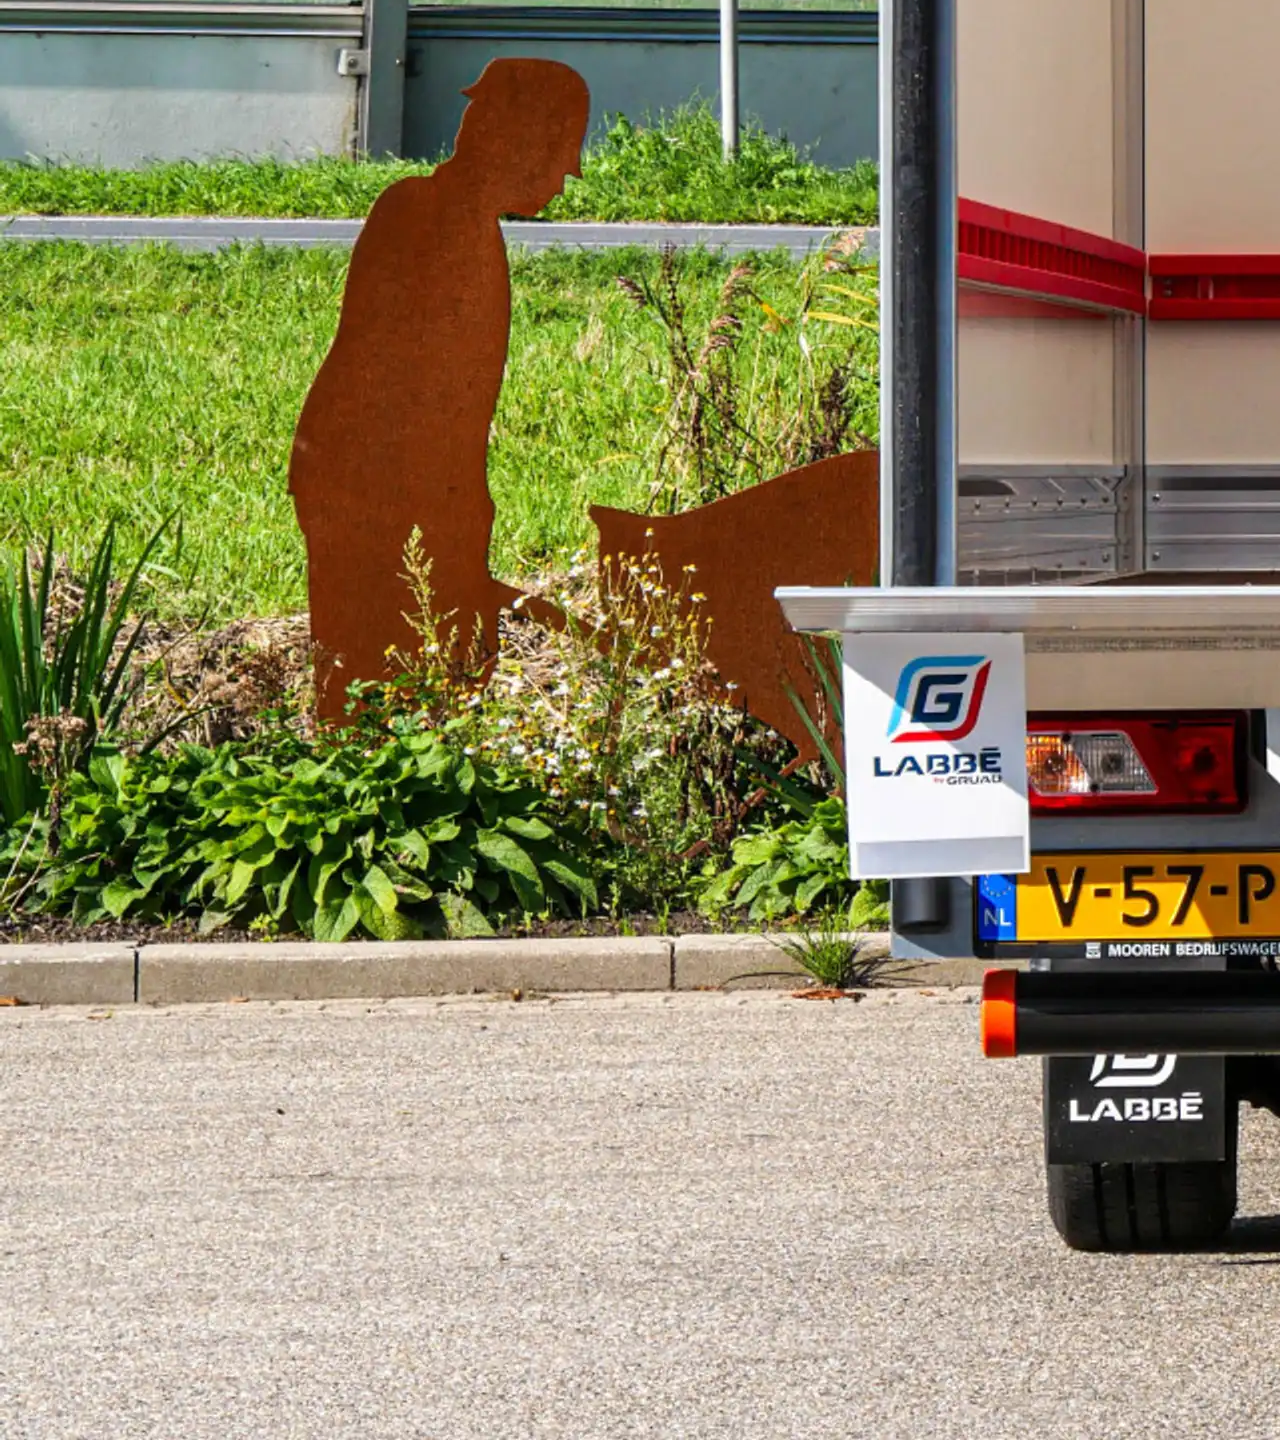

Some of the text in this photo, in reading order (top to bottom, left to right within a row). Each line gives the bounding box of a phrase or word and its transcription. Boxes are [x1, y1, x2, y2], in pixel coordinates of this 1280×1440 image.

[946, 774, 1003, 786] GRUAU
[983, 907, 1012, 927] NL
[1107, 943, 1171, 958] MOOREN
